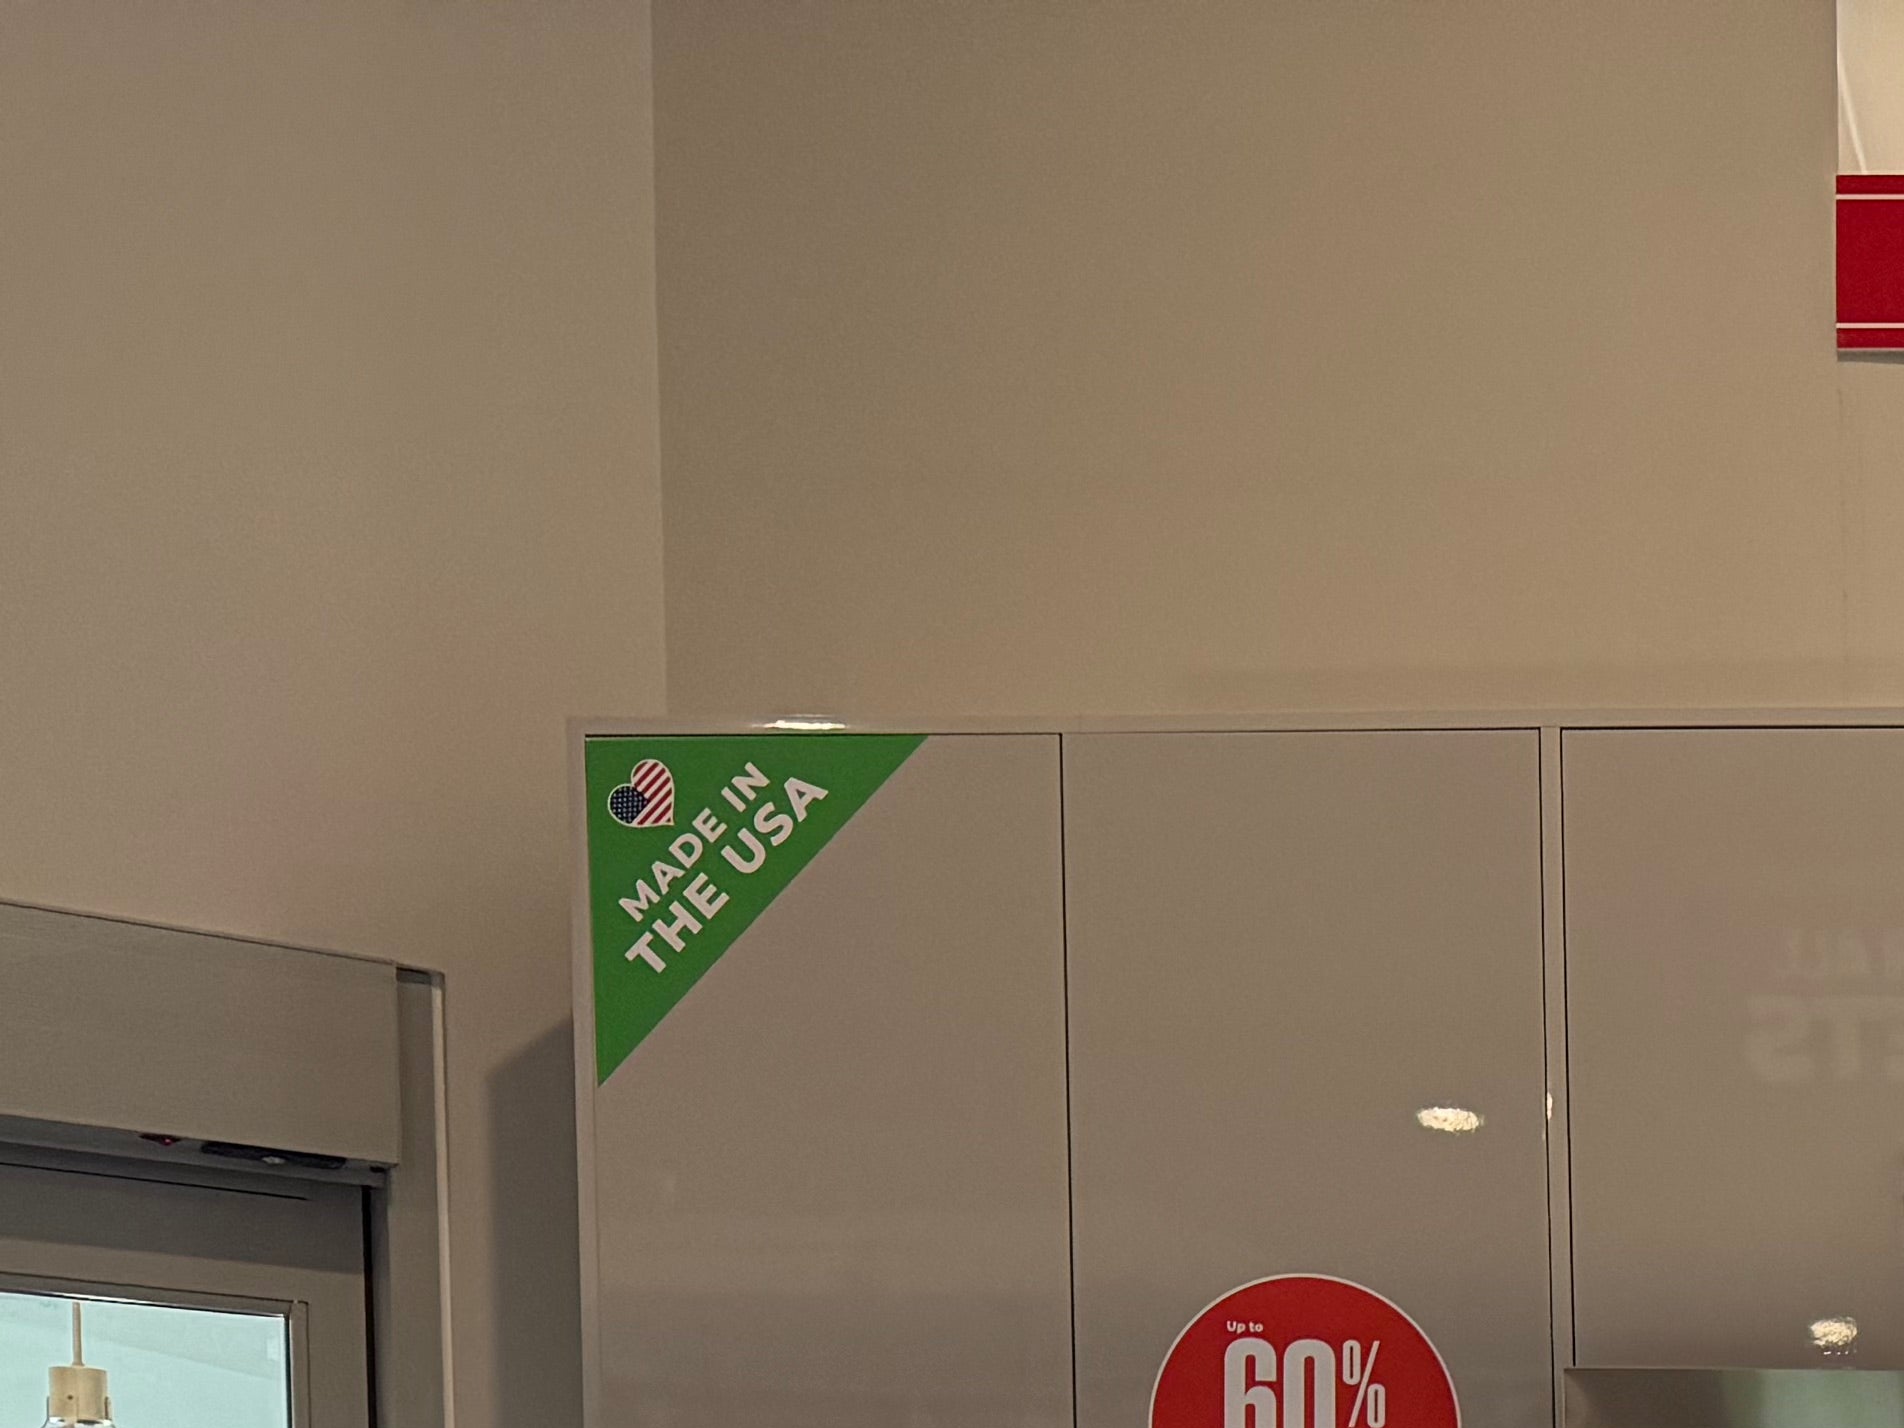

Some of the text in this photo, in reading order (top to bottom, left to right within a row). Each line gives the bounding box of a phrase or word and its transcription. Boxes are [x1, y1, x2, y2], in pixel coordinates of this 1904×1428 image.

[618, 761, 771, 923] MADE IN
[624, 776, 829, 974] THE USA
[1226, 1320, 1264, 1334] Up to
